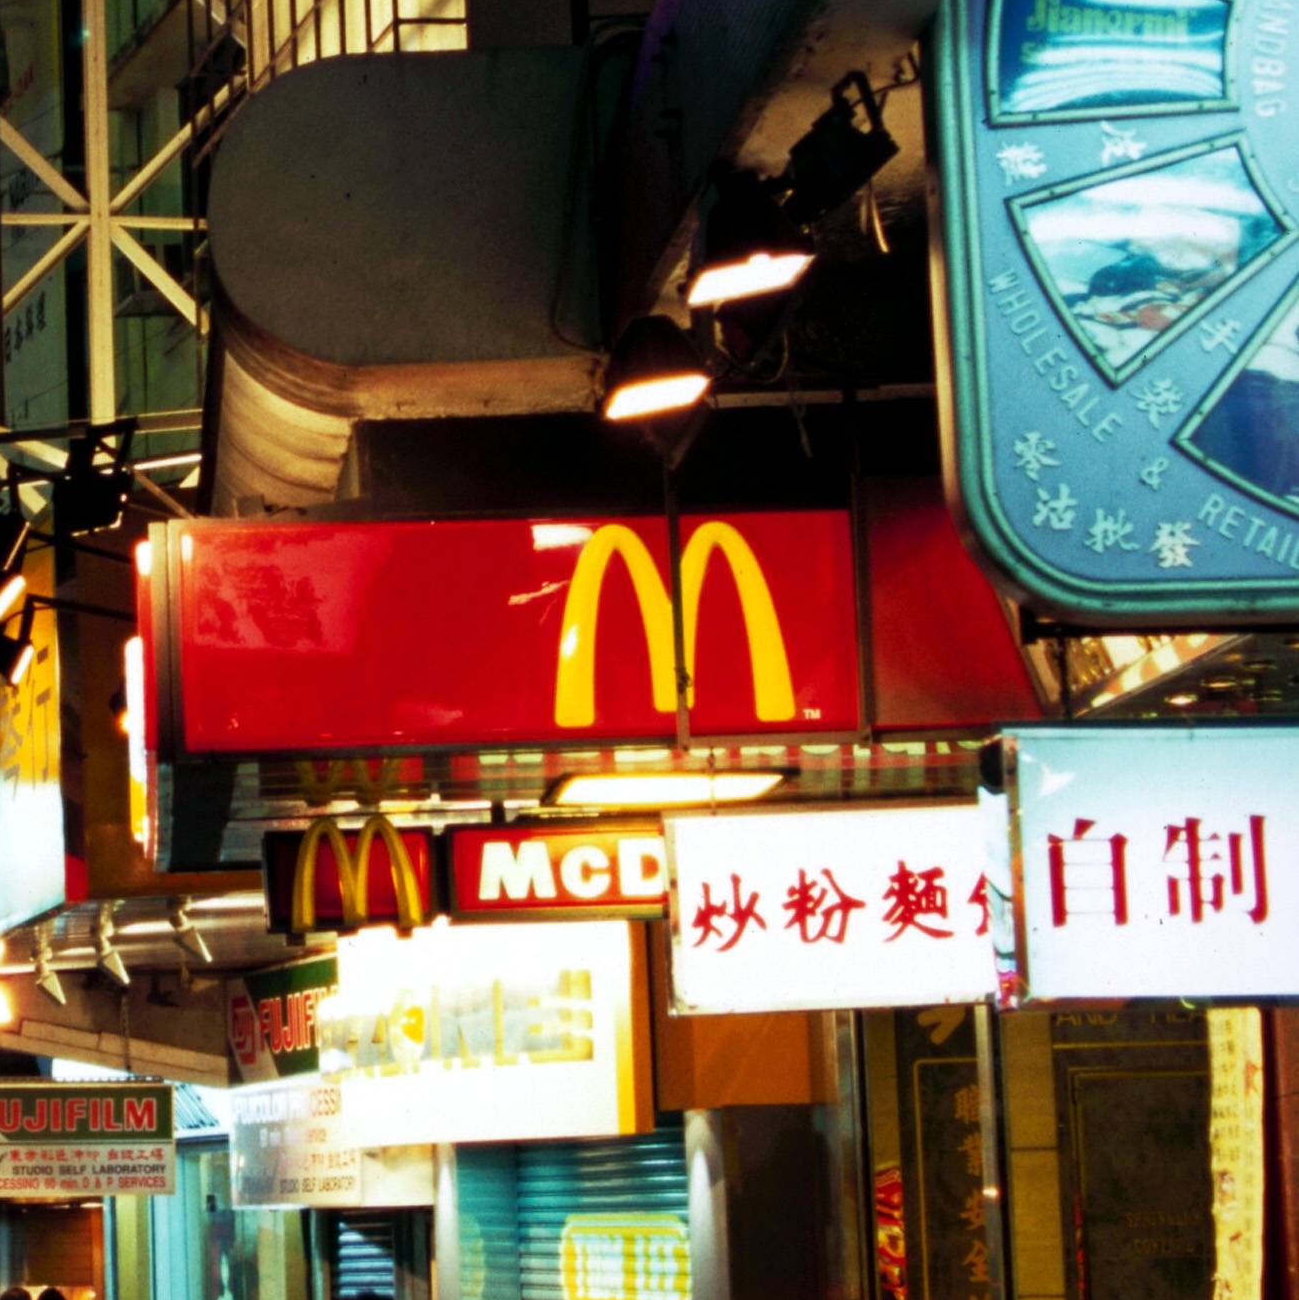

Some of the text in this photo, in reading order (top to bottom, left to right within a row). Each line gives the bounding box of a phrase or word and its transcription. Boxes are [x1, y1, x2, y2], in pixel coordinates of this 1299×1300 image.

[987, 268, 1125, 444] WHOLESALE
[478, 839, 668, 901] McD
[12, 1163, 166, 1176] STUDIO SELF LABORATORY
[118, 1176, 166, 1189] SERVICES
